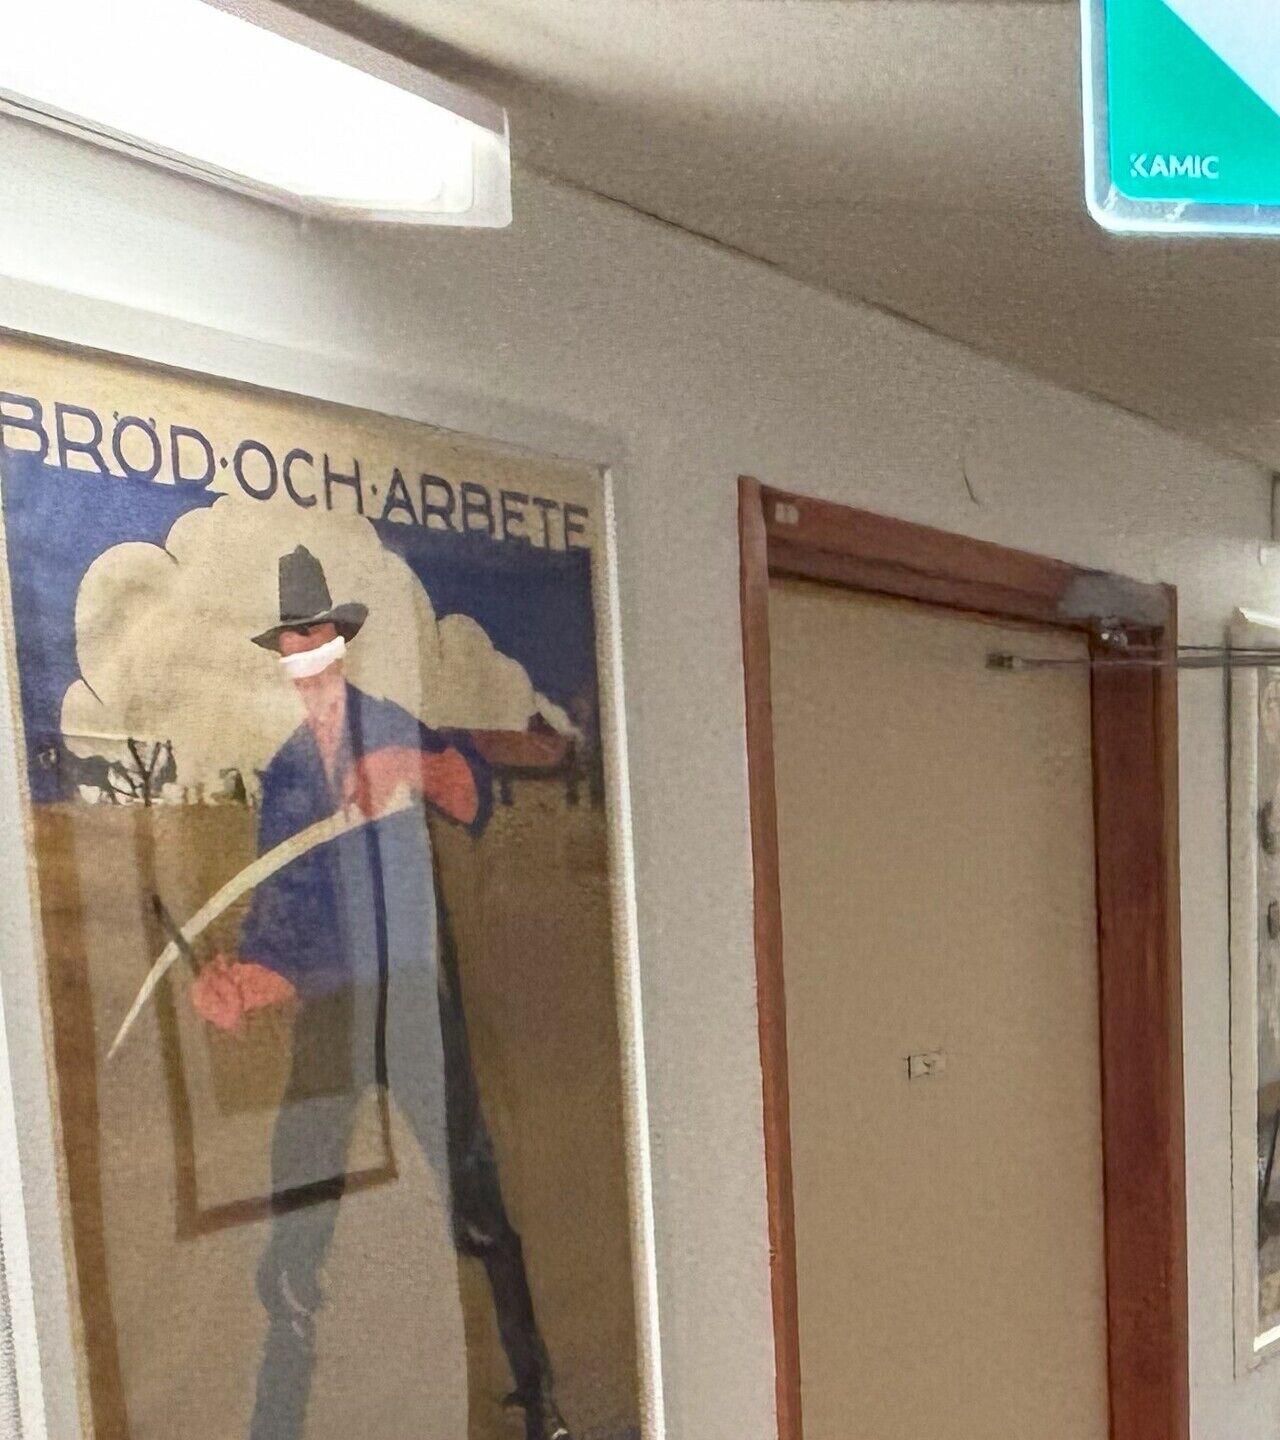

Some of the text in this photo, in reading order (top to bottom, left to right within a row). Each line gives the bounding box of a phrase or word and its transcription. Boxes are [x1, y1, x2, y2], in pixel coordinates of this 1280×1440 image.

[1130, 153, 1219, 179] KAMIC
[234, 438, 364, 513] OCH
[381, 467, 590, 552] ARBETE
